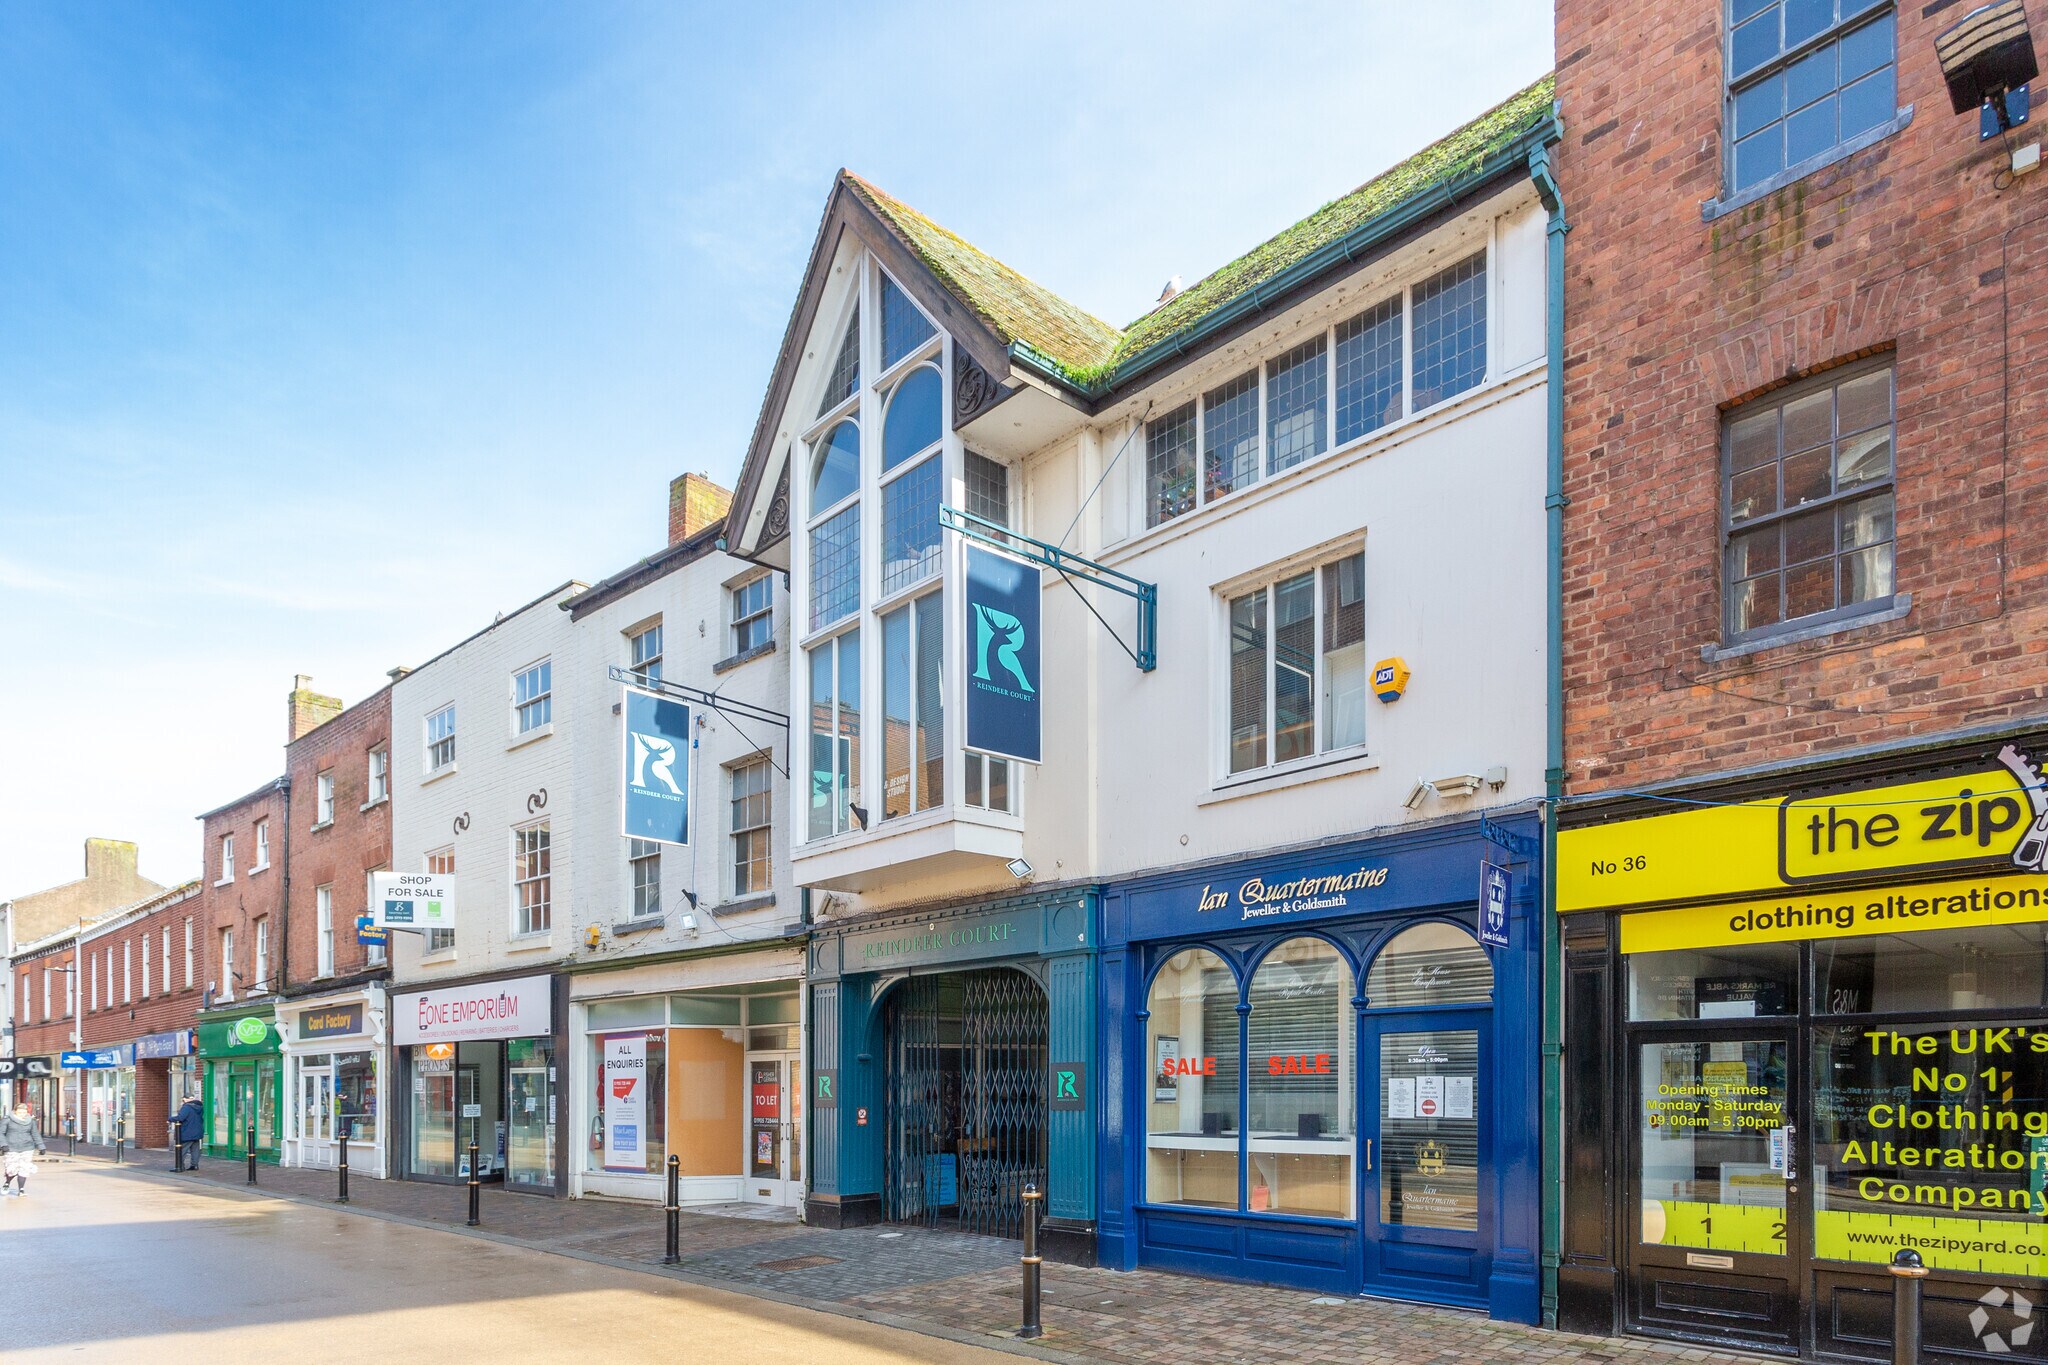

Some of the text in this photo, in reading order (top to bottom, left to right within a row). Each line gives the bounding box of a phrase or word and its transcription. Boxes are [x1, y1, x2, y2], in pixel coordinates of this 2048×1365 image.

[1376, 669, 1394, 684] ADT
[977, 682, 1031, 702] REINDEER COURT
[633, 788, 681, 802] REINDEER COURT
[1807, 788, 2022, 855] the zip
[1591, 855, 1647, 876] No 36
[400, 876, 431, 884] SHOP
[388, 888, 443, 897] FOR SALE
[1198, 867, 1389, 912] Ian Quartermaine
[1241, 894, 1347, 921] Jeweller & Goldsmith
[1729, 887, 2048, 932] clothing alteration
[359, 930, 387, 939] Factory
[950, 922, 1011, 947] COURT
[452, 994, 518, 1022] EMPORIUM
[241, 1023, 264, 1035] VPZ
[308, 1014, 351, 1031] Card Factory
[1864, 1027, 2048, 1055] The UK's
[618, 1046, 632, 1055] ALL
[420, 1060, 449, 1071] PHONES
[607, 1058, 644, 1069] ENQUIRIES
[1163, 1057, 1217, 1076] SALE
[1268, 1053, 1331, 1076] SALE
[1912, 1066, 1996, 1092] No 1
[1658, 1084, 1768, 1097] Opening Times
[755, 1095, 777, 1105] TO LET
[1646, 1099, 1701, 1112] Monday
[1714, 1099, 1782, 1113] Saturday
[1649, 1115, 1709, 1126] 09.00am
[1722, 1115, 1779, 1130] 5.30pm
[1868, 1104, 2048, 1137] Clothing
[1842, 1140, 2048, 1170] Alteration
[1402, 1192, 1459, 1206] Quartermaine
[1859, 1177, 2048, 1217] Company
[1700, 1217, 1712, 1234] 1
[1771, 1222, 1787, 1240] 2
[1847, 1232, 2047, 1257] www.thezipyard.co.
